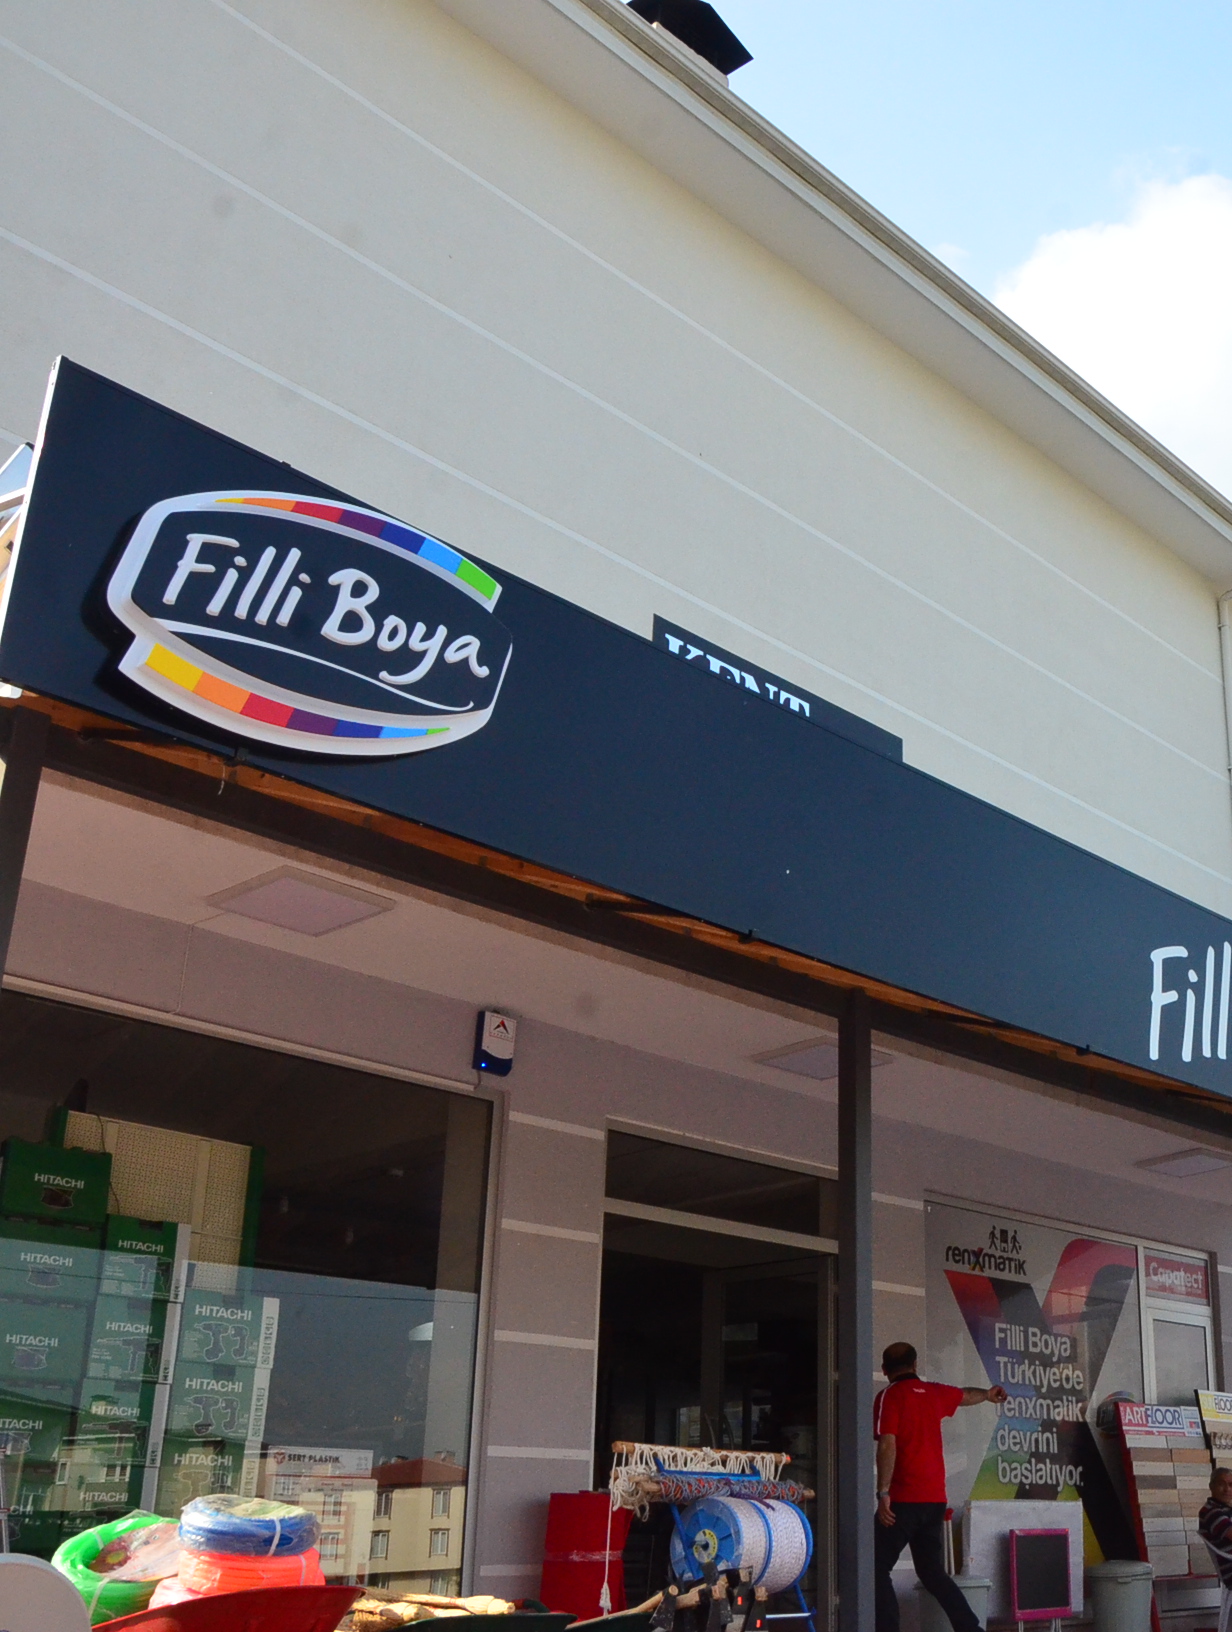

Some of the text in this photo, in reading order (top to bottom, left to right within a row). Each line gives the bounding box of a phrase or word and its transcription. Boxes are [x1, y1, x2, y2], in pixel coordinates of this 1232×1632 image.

[162, 533, 490, 685] Filli Boya
[34, 1173, 85, 1189] HITACHI
[118, 1239, 164, 1253] HITACHI
[20, 1252, 73, 1267] HITACHI
[1150, 1262, 1203, 1289] Capatect
[195, 1304, 252, 1321] HITACHI
[106, 1321, 153, 1334] HITACHI
[5, 1333, 59, 1347] HITACHI
[995, 1322, 1071, 1361] Filli Boya
[995, 1356, 1084, 1393] Türkiye'de
[185, 1377, 243, 1393] HITACHI
[92, 1405, 140, 1417] HITACHI
[1125, 1405, 1182, 1426] ARTFLOOR
[0, 1418, 43, 1430] ITACHI
[996, 1424, 1059, 1454] devrini
[174, 1453, 232, 1467] HITACHI
[80, 1491, 128, 1502] HITACHI
